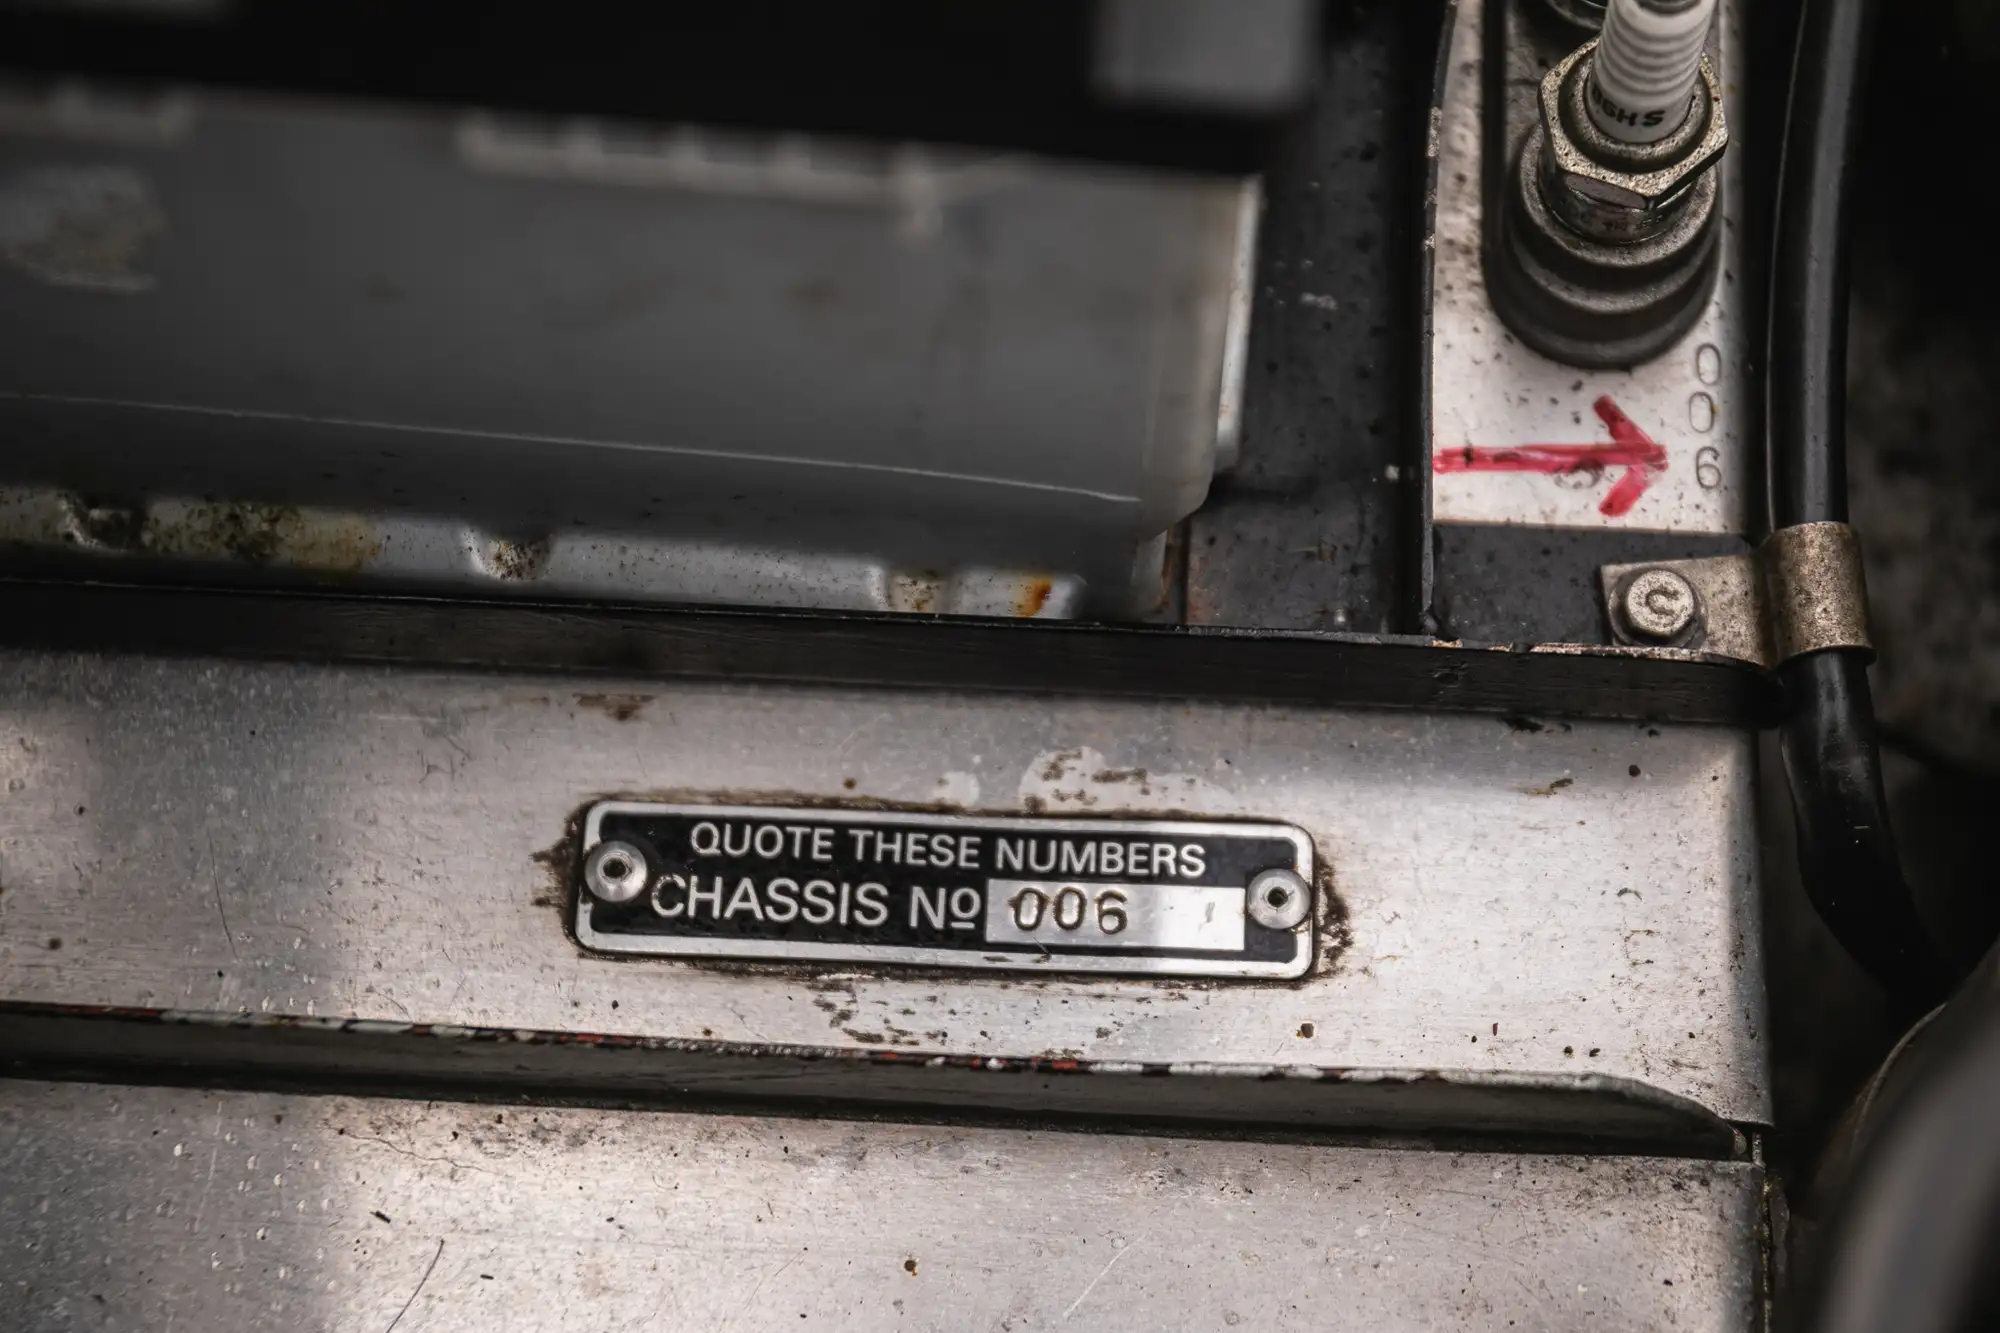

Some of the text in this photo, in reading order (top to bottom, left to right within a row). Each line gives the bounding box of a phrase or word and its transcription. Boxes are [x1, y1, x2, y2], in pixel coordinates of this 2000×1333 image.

[1689, 342, 1722, 490] 006
[689, 821, 1207, 878] QUOTE THESE NUMBERS
[650, 873, 889, 927] CHASSIS
[1008, 885, 1128, 935] 006
